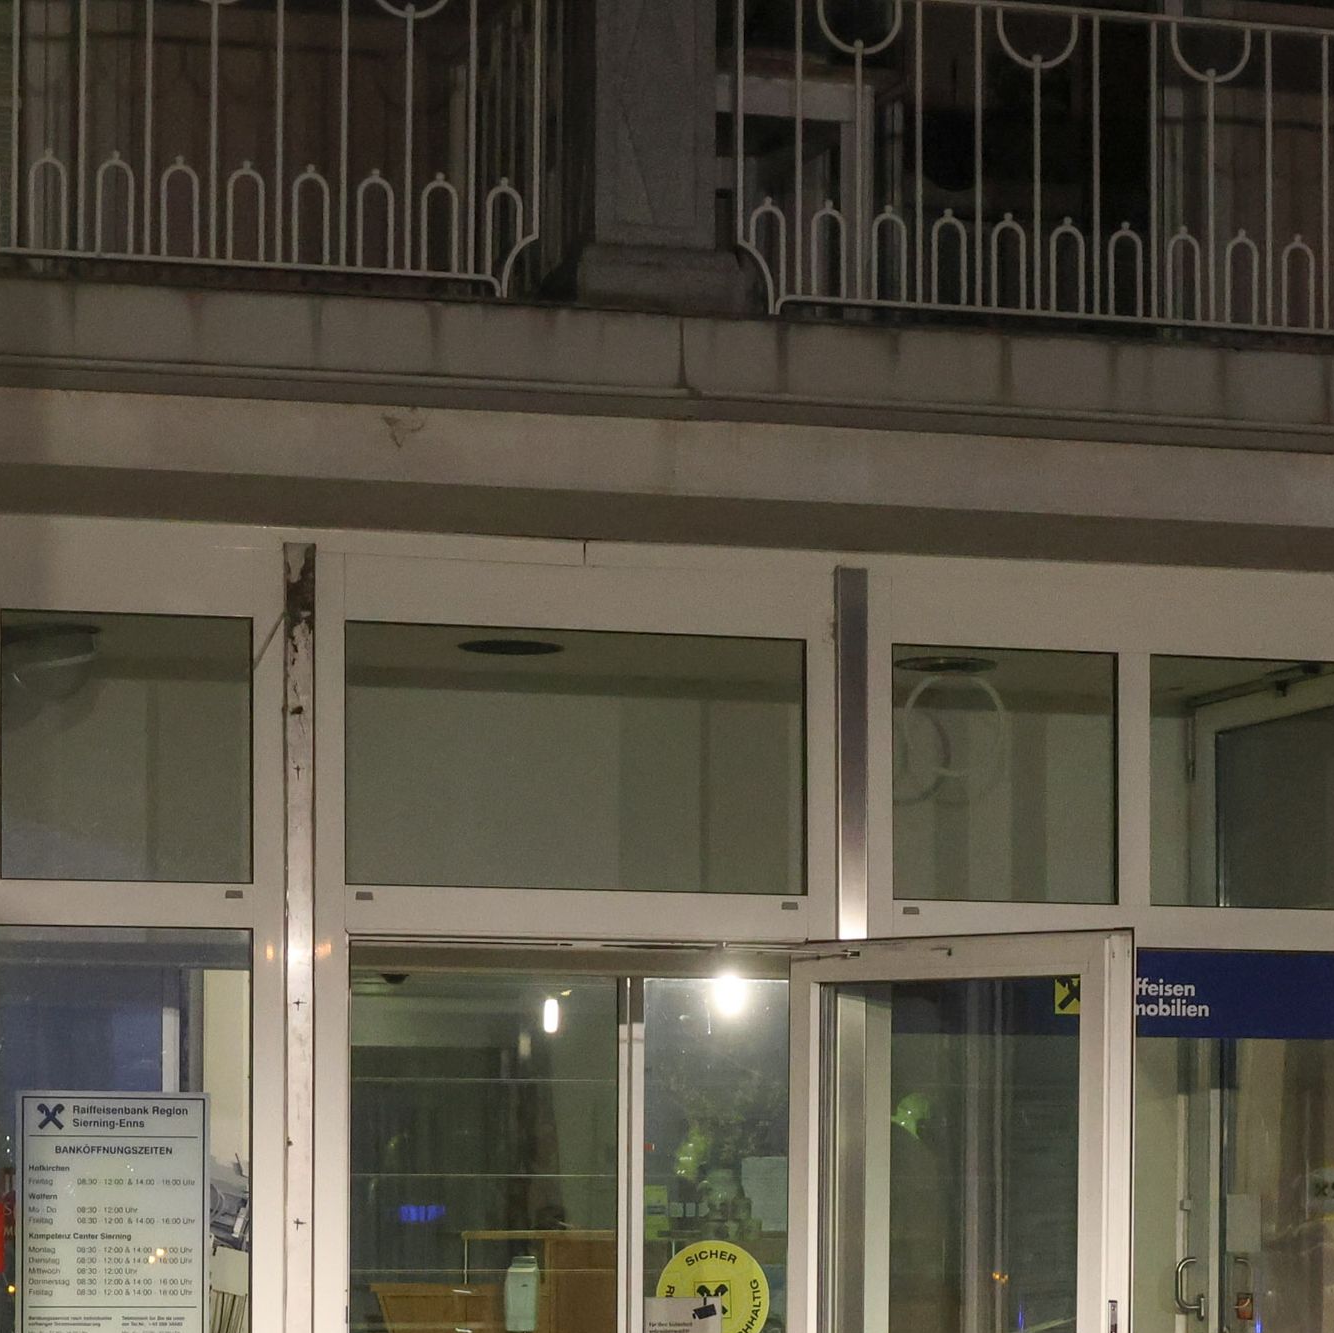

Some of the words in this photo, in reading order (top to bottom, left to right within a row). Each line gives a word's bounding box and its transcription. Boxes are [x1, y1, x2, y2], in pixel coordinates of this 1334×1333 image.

[72, 1104, 149, 1116] Raiffeisenbank
[152, 1105, 189, 1118] Region
[72, 1118, 145, 1130] Sierning-Enns
[54, 1143, 173, 1156] BANKÖFFNUNGSZEITEN
[100, 1232, 132, 1241] Sierning
[685, 1250, 737, 1266] SICHER
